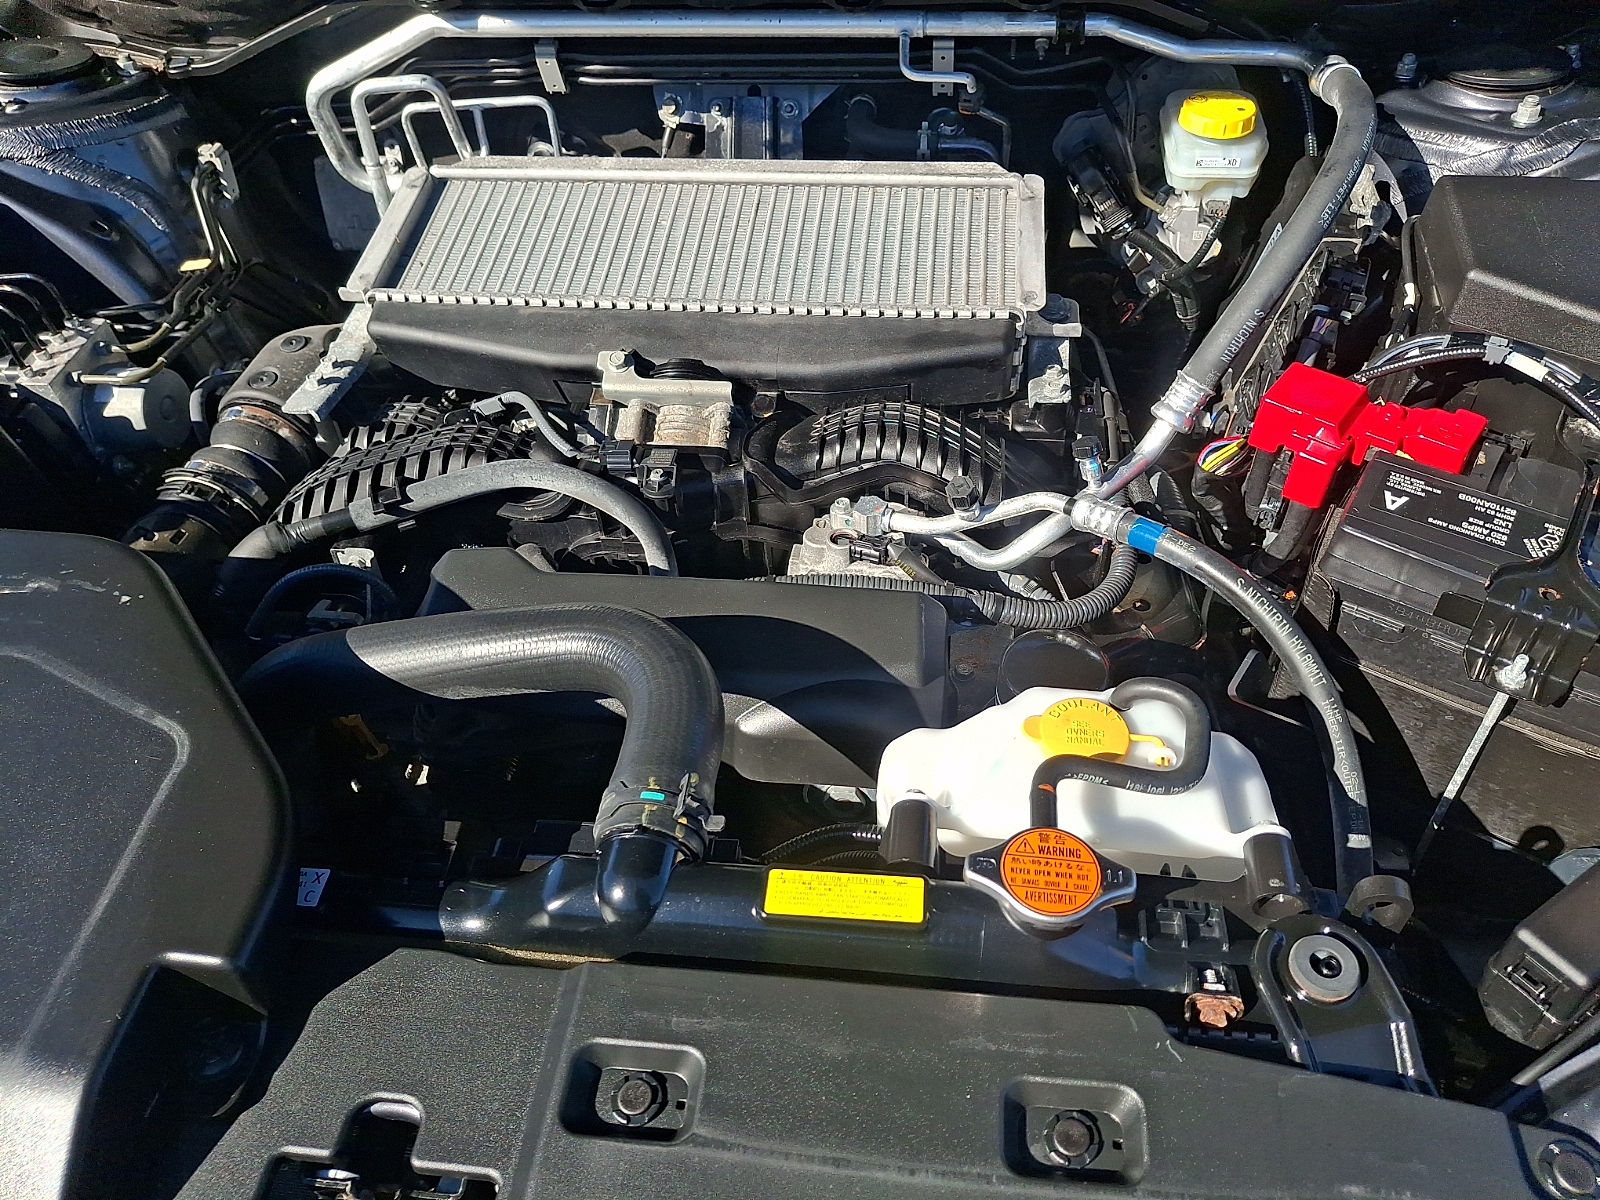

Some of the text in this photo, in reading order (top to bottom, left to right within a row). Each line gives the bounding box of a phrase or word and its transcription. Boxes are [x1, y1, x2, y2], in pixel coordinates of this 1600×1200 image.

[1384, 490, 1410, 510] A
[1461, 521, 1490, 535] AMPS
[1468, 517, 1510, 534] GROUP SIZE
[1493, 517, 1512, 528] LN2
[1427, 517, 1506, 546] COLD CRANKING AMPS
[1288, 635, 1326, 687] HYLAMMIT
[1049, 699, 1122, 722] COOLANT
[1066, 736, 1106, 746] MANUAL
[1038, 832, 1068, 845] 警告
[1038, 844, 1082, 858] WARNING
[311, 872, 326, 884] X
[811, 874, 842, 882] CAUTION
[846, 876, 886, 885] ATTENTION
[1010, 866, 1030, 876] NEVER
[1034, 868, 1052, 877] OPEN
[1055, 871, 1073, 880] WHEN
[304, 890, 316, 903] C
